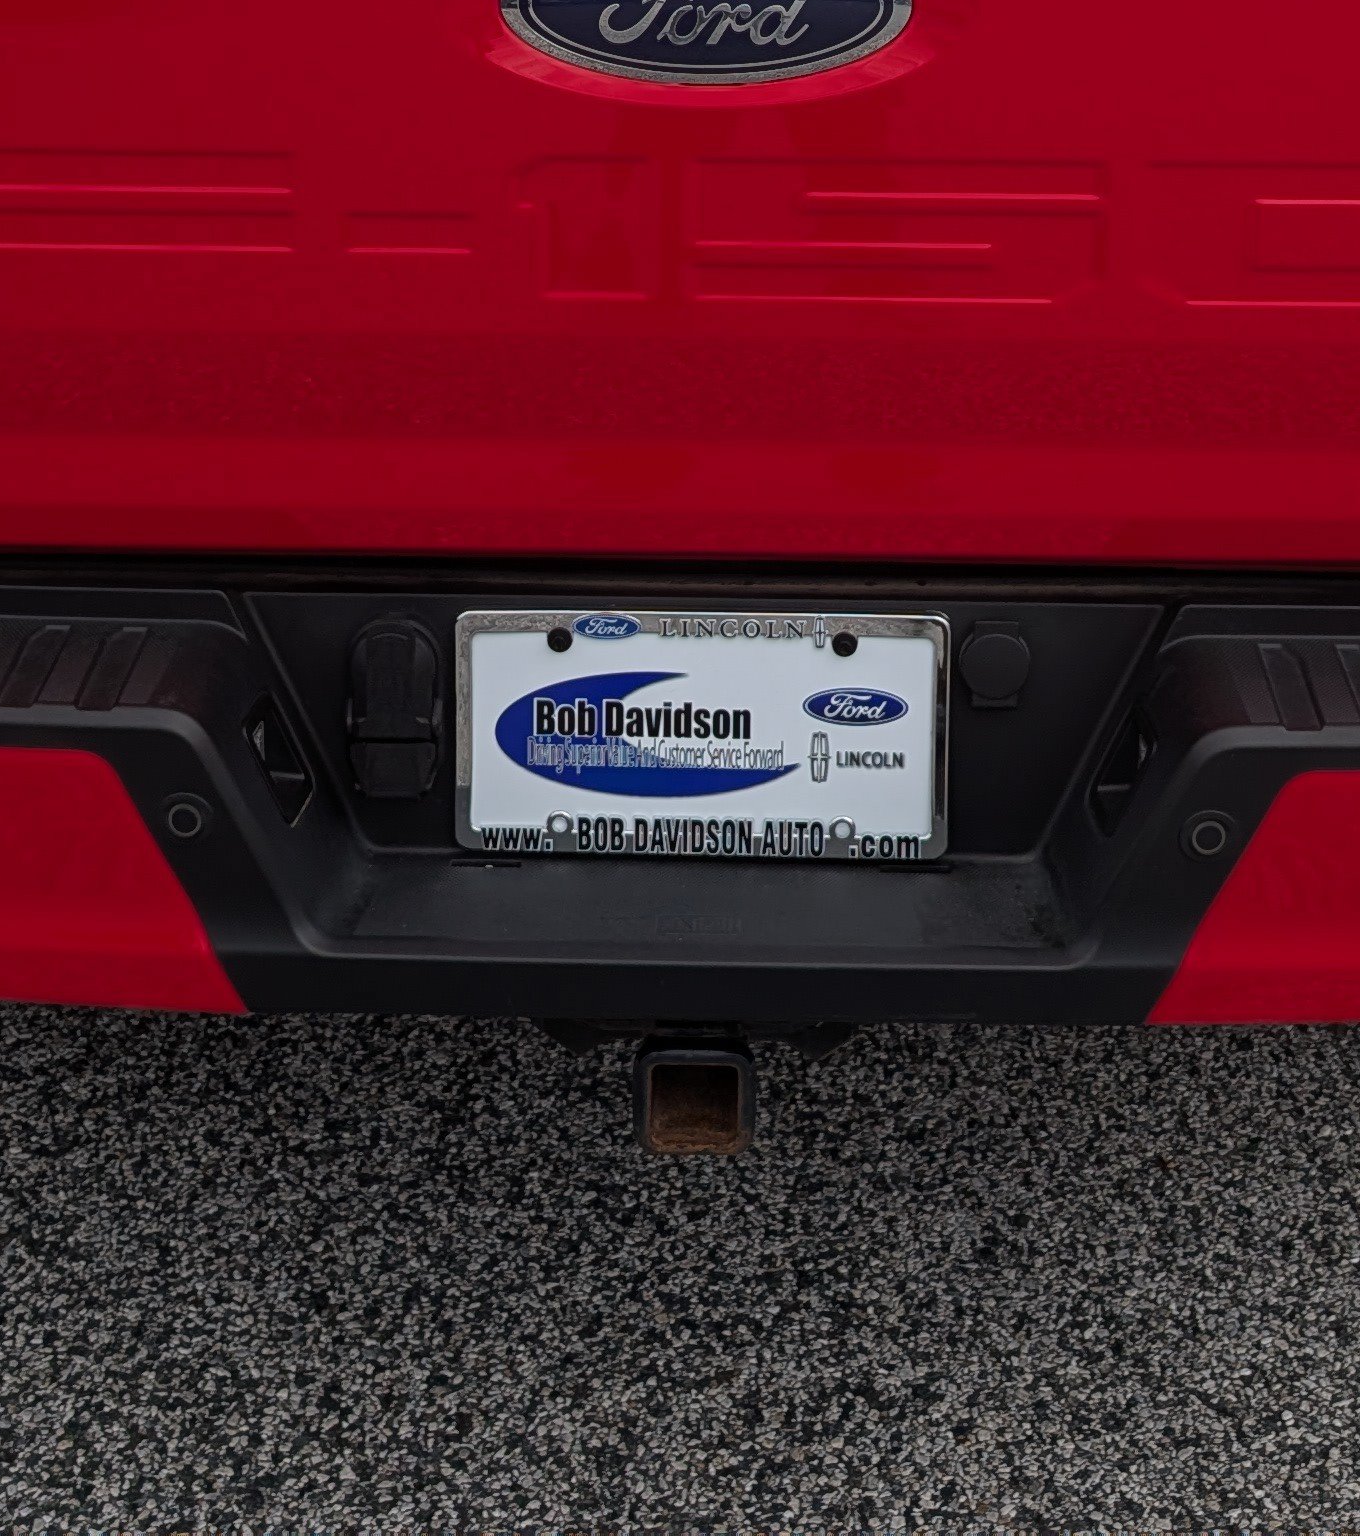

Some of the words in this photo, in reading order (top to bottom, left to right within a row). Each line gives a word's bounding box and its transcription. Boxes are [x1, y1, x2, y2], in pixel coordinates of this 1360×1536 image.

[659, 618, 806, 639] LINCOLN
[534, 698, 597, 737] Bob
[602, 701, 751, 740] Davidson
[824, 694, 886, 720] Ford
[527, 736, 564, 774] Driving
[564, 736, 607, 774] Superior
[658, 739, 706, 769] Customer
[707, 740, 742, 770] Service
[743, 741, 785, 771] Forward
[836, 751, 905, 769] LINCOLN
[578, 816, 625, 851] BOB
[633, 818, 753, 855] DAVIDSON
[761, 819, 825, 857] AUTO
